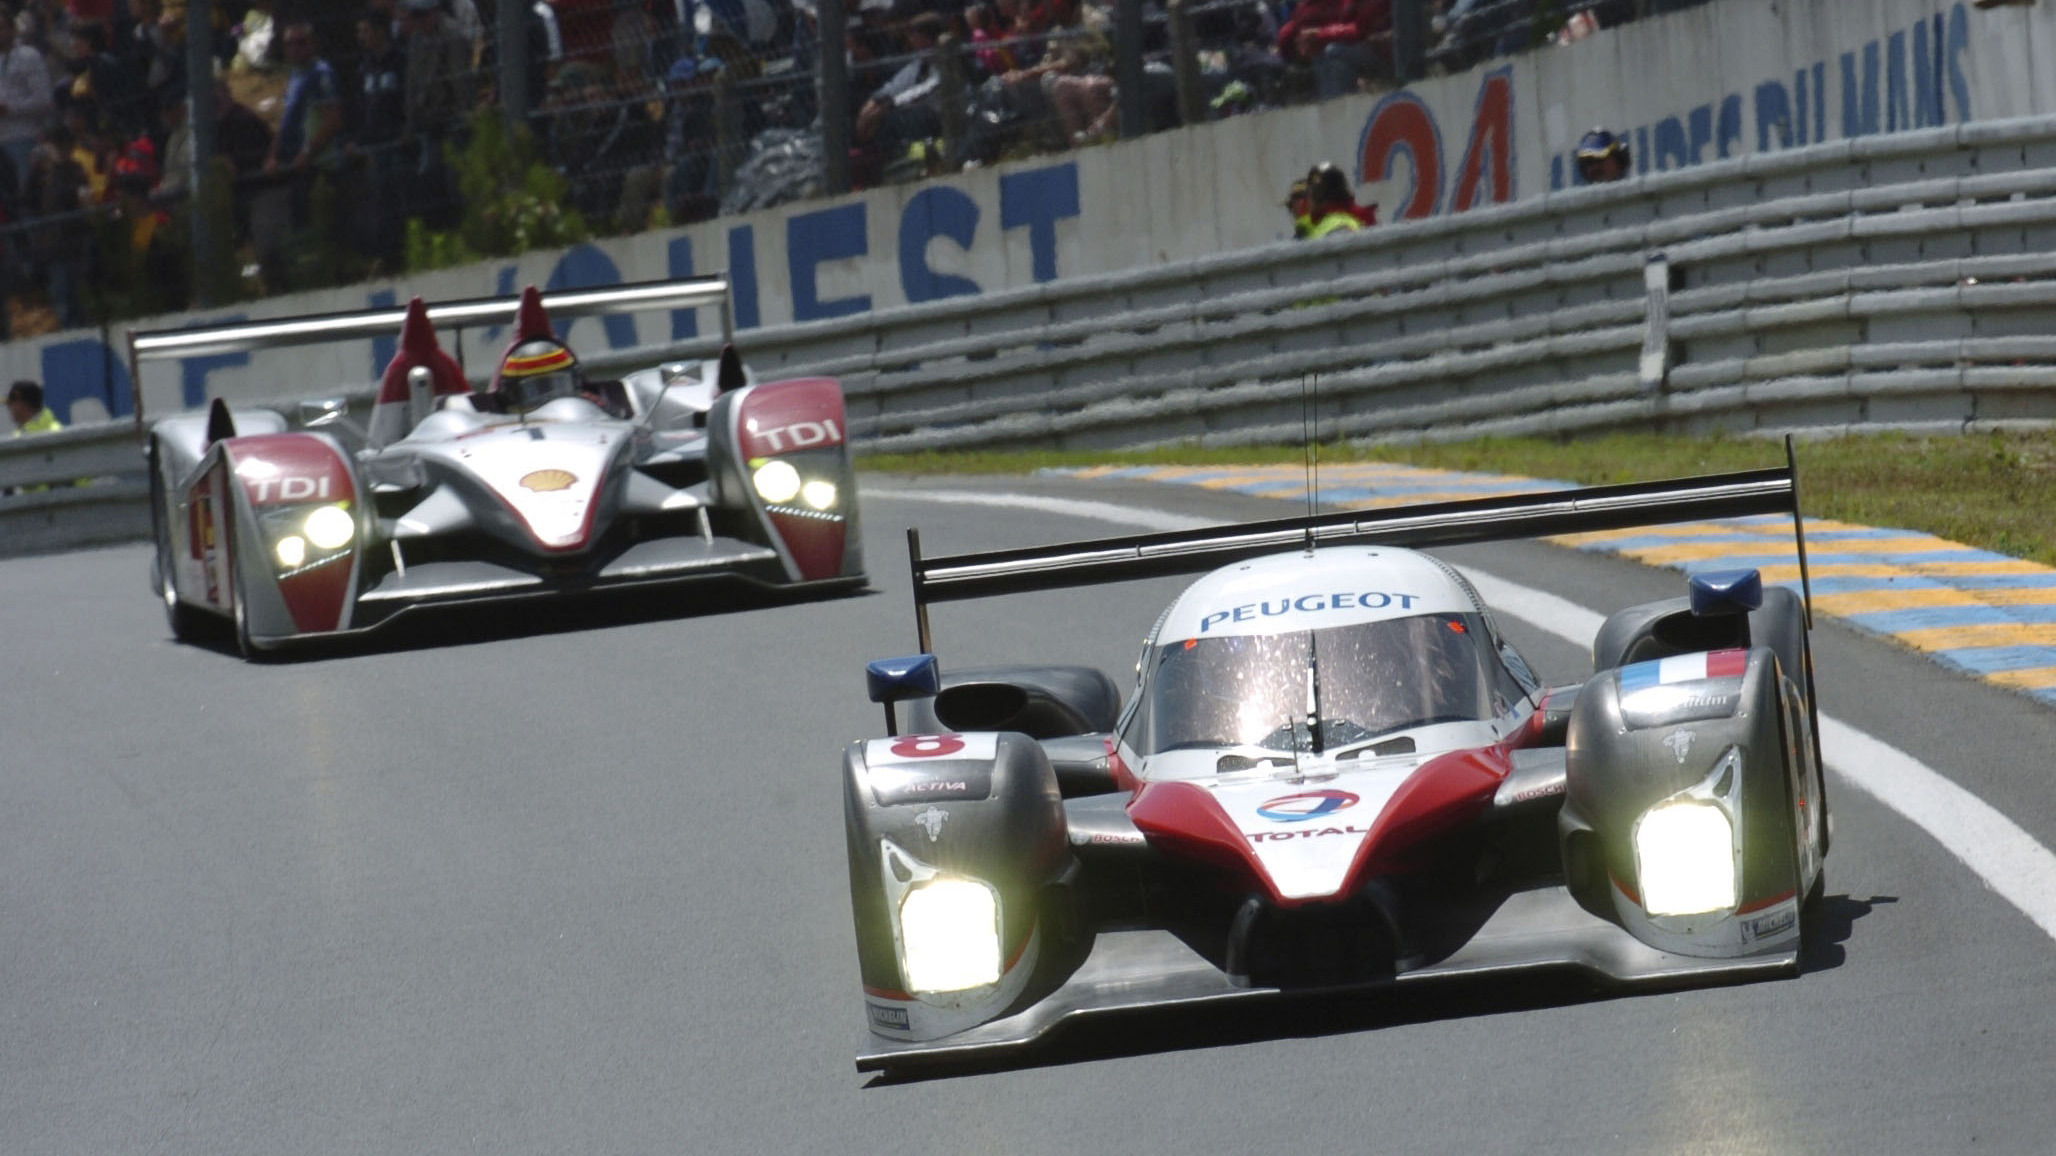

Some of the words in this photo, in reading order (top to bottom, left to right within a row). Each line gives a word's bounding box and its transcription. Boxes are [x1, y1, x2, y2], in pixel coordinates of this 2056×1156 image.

[1354, 63, 1518, 224] 24
[752, 418, 842, 452] TDI
[248, 476, 331, 502] TDI
[1200, 592, 1421, 633] PEUGEOT
[890, 732, 966, 758] 8
[904, 780, 968, 794] ACTIVA
[1515, 782, 1567, 802] BOSCH
[1091, 833, 1142, 845] BOSCH
[1245, 825, 1370, 843] TOTAL
